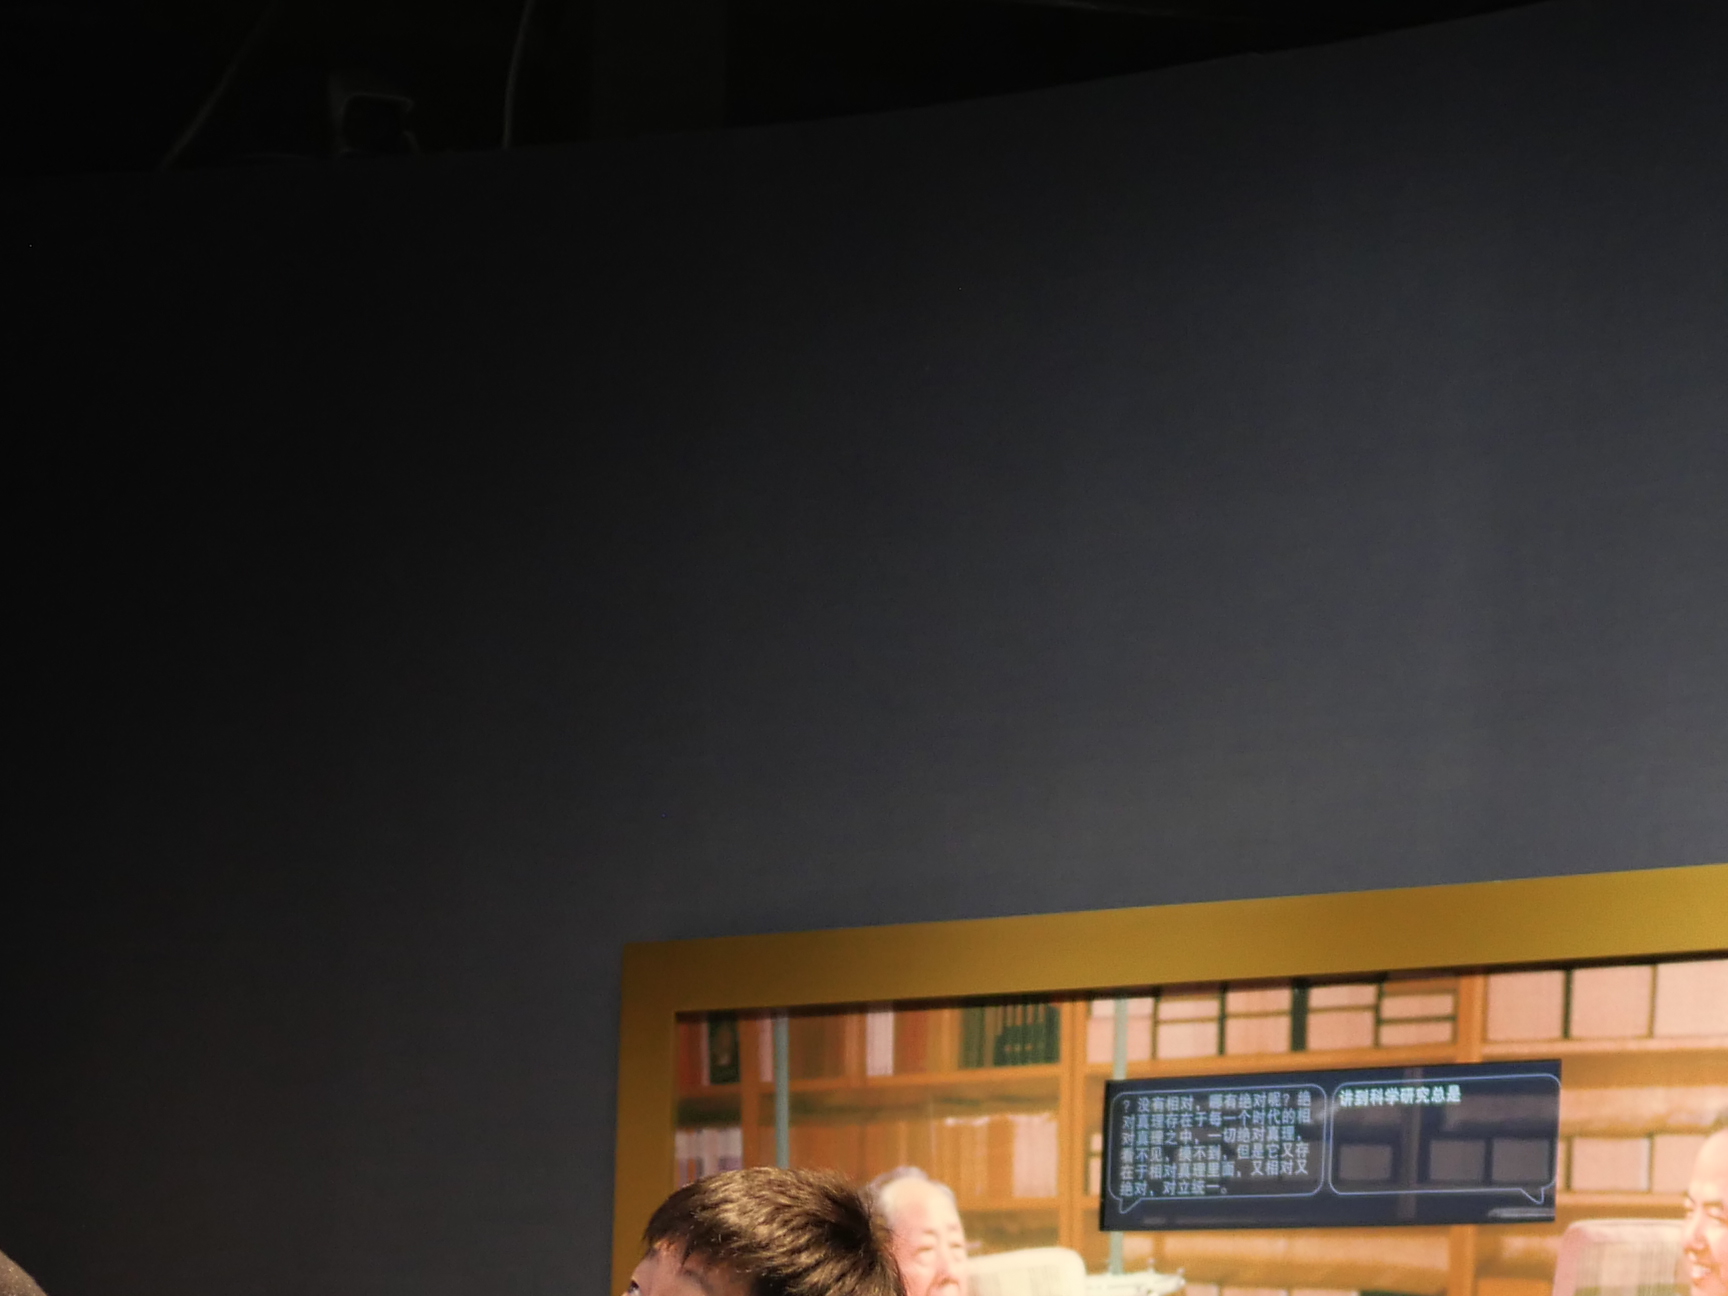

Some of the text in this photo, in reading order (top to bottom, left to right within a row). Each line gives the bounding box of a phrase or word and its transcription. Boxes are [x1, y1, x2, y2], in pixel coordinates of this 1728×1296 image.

[1338, 1084, 1461, 1107] 讲到科学研究总是
[1122, 1108, 1311, 1130] 对真理存在于每一个时代的相
